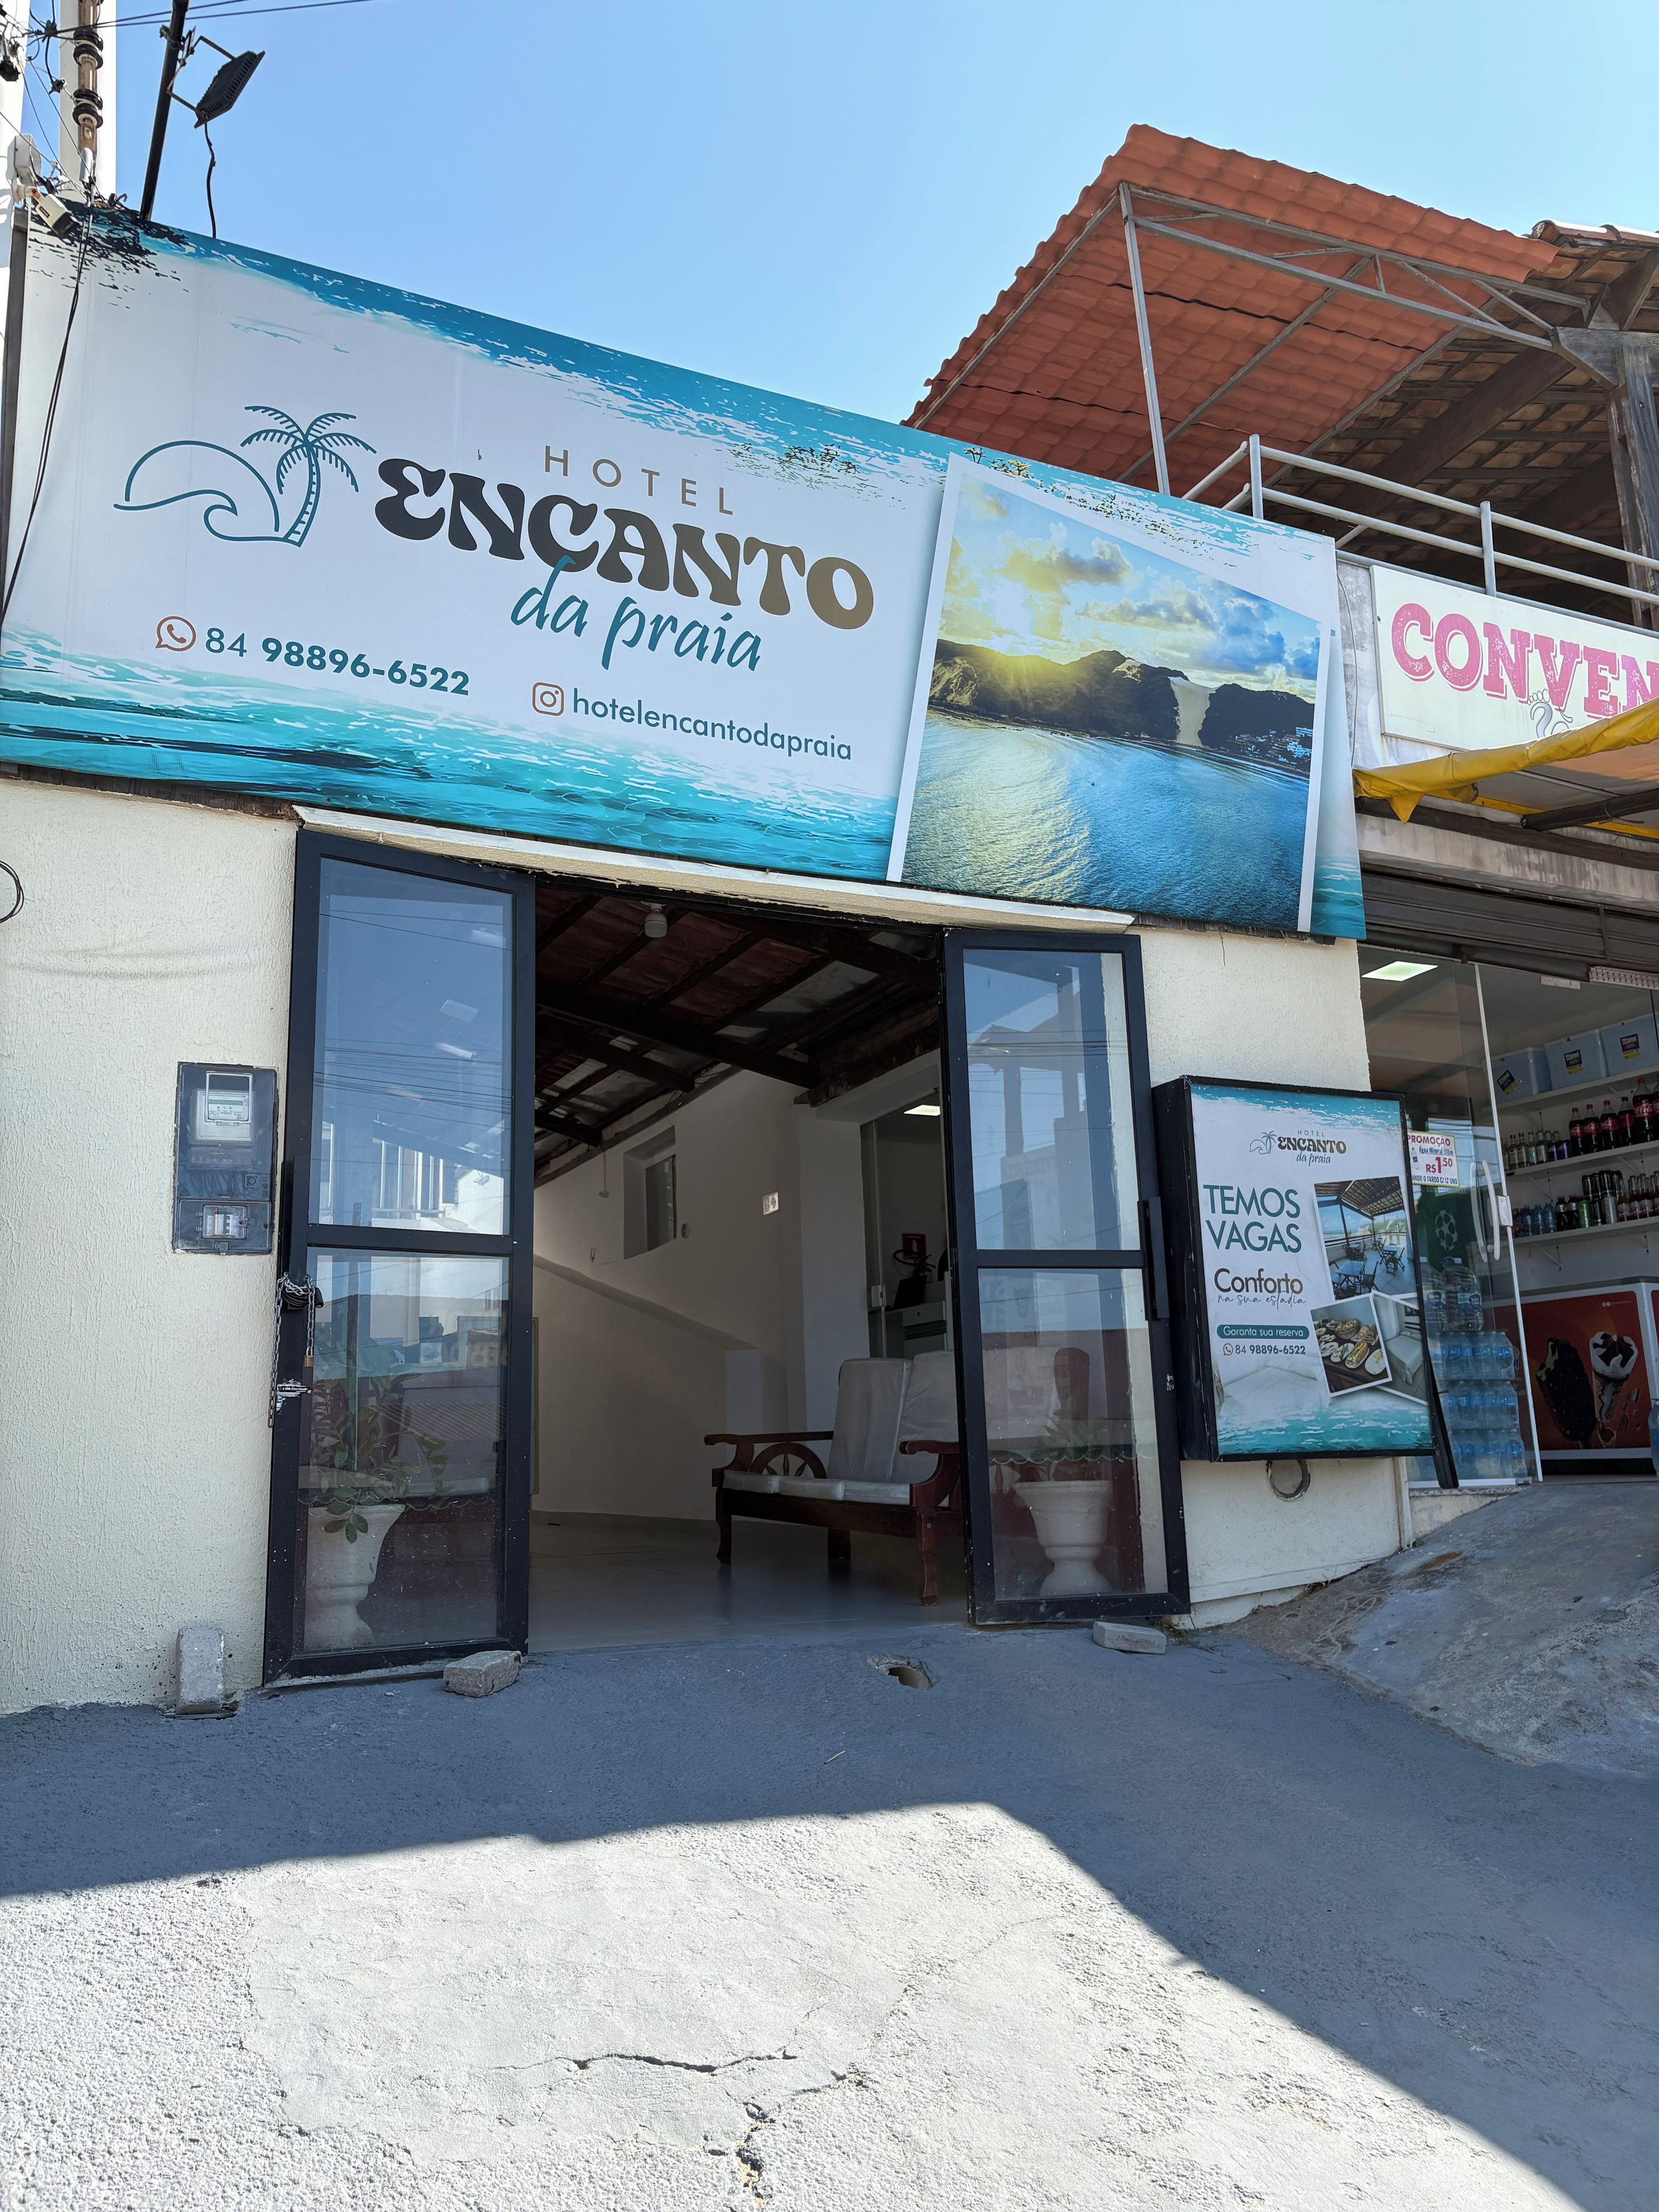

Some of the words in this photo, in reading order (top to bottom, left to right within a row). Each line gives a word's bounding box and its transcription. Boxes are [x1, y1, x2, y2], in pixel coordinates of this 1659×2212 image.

[544, 445, 734, 516] HOTEL
[374, 458, 874, 630] ENCANTO
[510, 555, 588, 638] da
[601, 596, 761, 672] praia
[205, 627, 248, 658] 84
[262, 637, 470, 696] 98896-6522
[1391, 602, 1659, 720] CONVEN
[573, 688, 851, 760] hotelencantodapraia
[1277, 1137, 1347, 1154] ENCANTO
[1296, 1150, 1306, 1162] da
[1308, 1153, 1331, 1166] praia
[1203, 1184, 1300, 1218] TEMOS
[1206, 1220, 1301, 1253] VAGAS
[1214, 1268, 1303, 1294] Conforto
[1217, 1294, 1233, 1303] na
[1237, 1294, 1262, 1305] sua
[1223, 1326, 1256, 1336] Garanta
[1235, 1344, 1246, 1354] 84
[1249, 1345, 1306, 1354] 98896-6522
